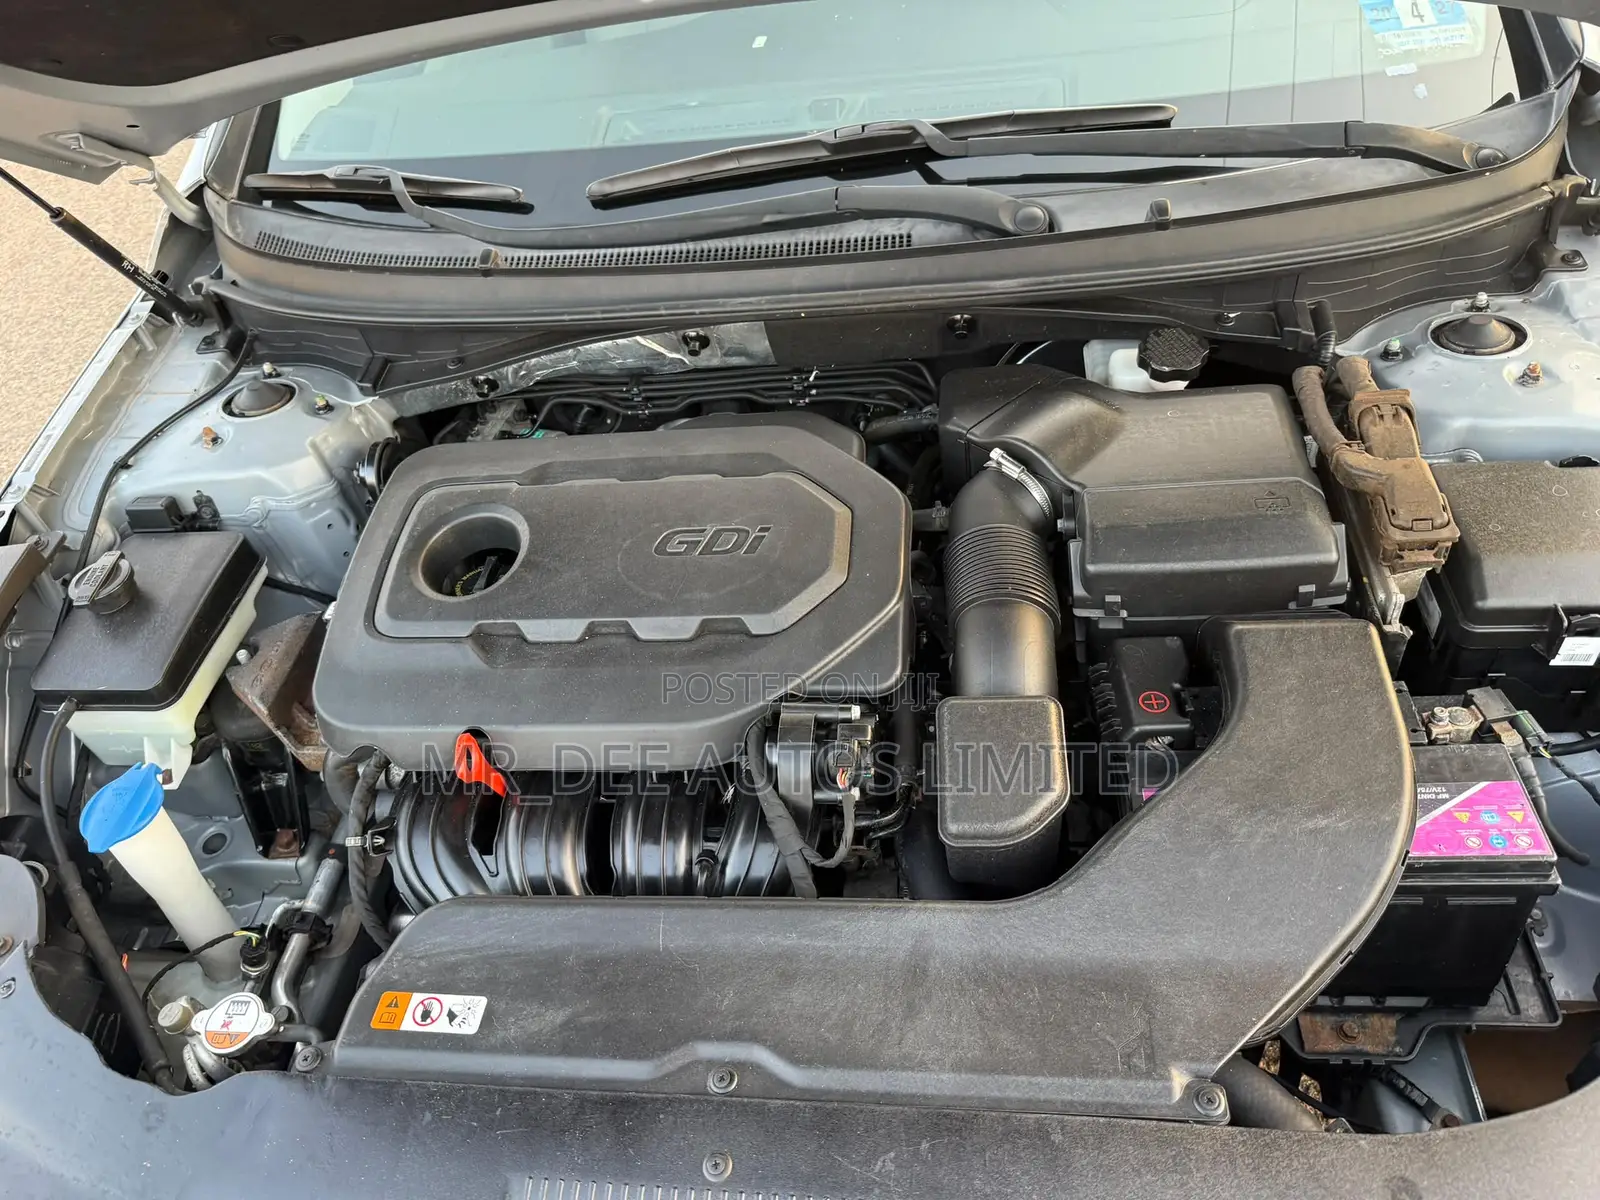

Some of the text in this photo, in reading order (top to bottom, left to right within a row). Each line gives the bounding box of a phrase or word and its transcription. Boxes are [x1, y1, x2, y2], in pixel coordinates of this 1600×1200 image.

[1411, 1, 1425, 23] 4
[121, 260, 135, 273] RH
[652, 525, 774, 557] GDi
[83, 566, 101, 586] ENGINE
[90, 564, 109, 588] COOLANT
